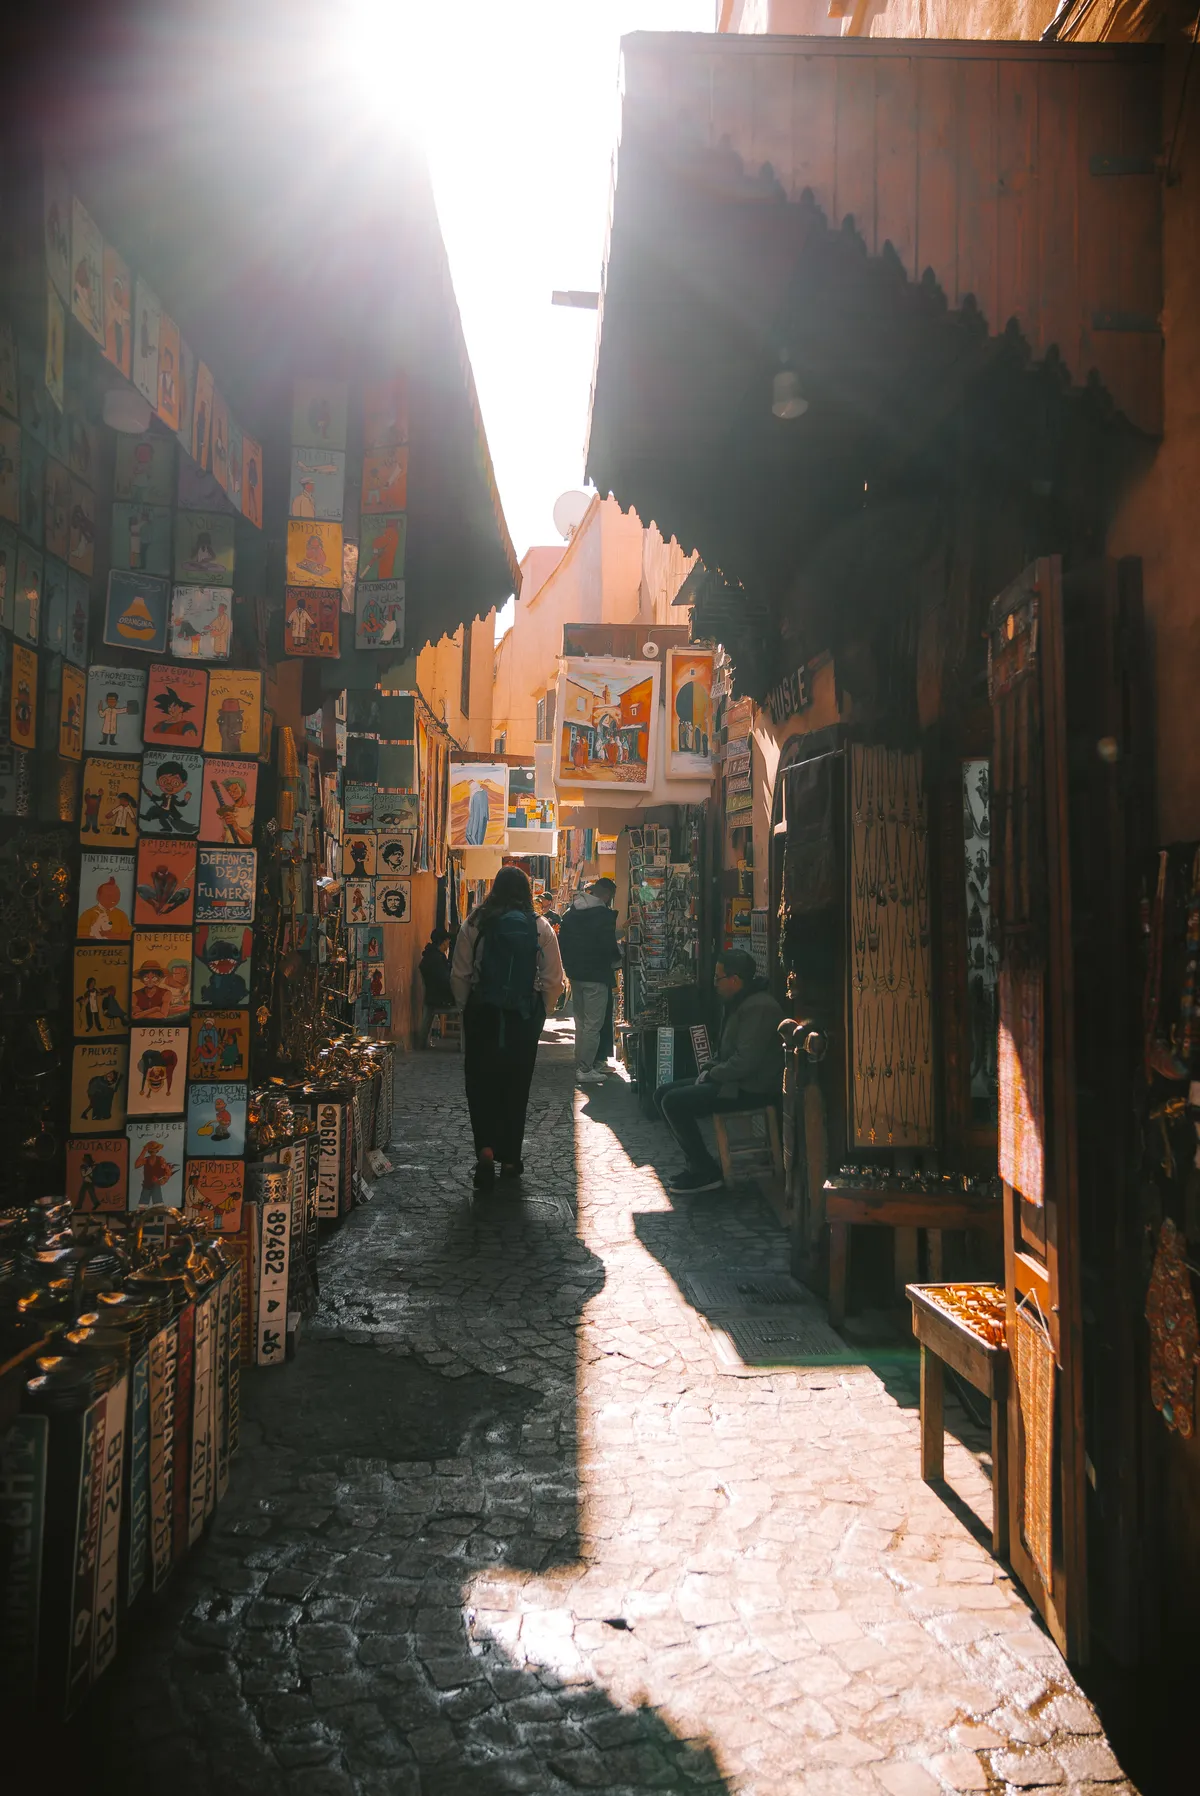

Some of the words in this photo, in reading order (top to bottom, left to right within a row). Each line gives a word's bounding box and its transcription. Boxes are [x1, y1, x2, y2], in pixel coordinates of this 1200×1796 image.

[200, 854, 253, 866] DEFFONCE
[215, 867, 234, 879] DE
[136, 933, 160, 942] ONE
[162, 934, 192, 943] PIECE
[139, 1028, 181, 1038] JOKER
[265, 1211, 287, 1276] 89482
